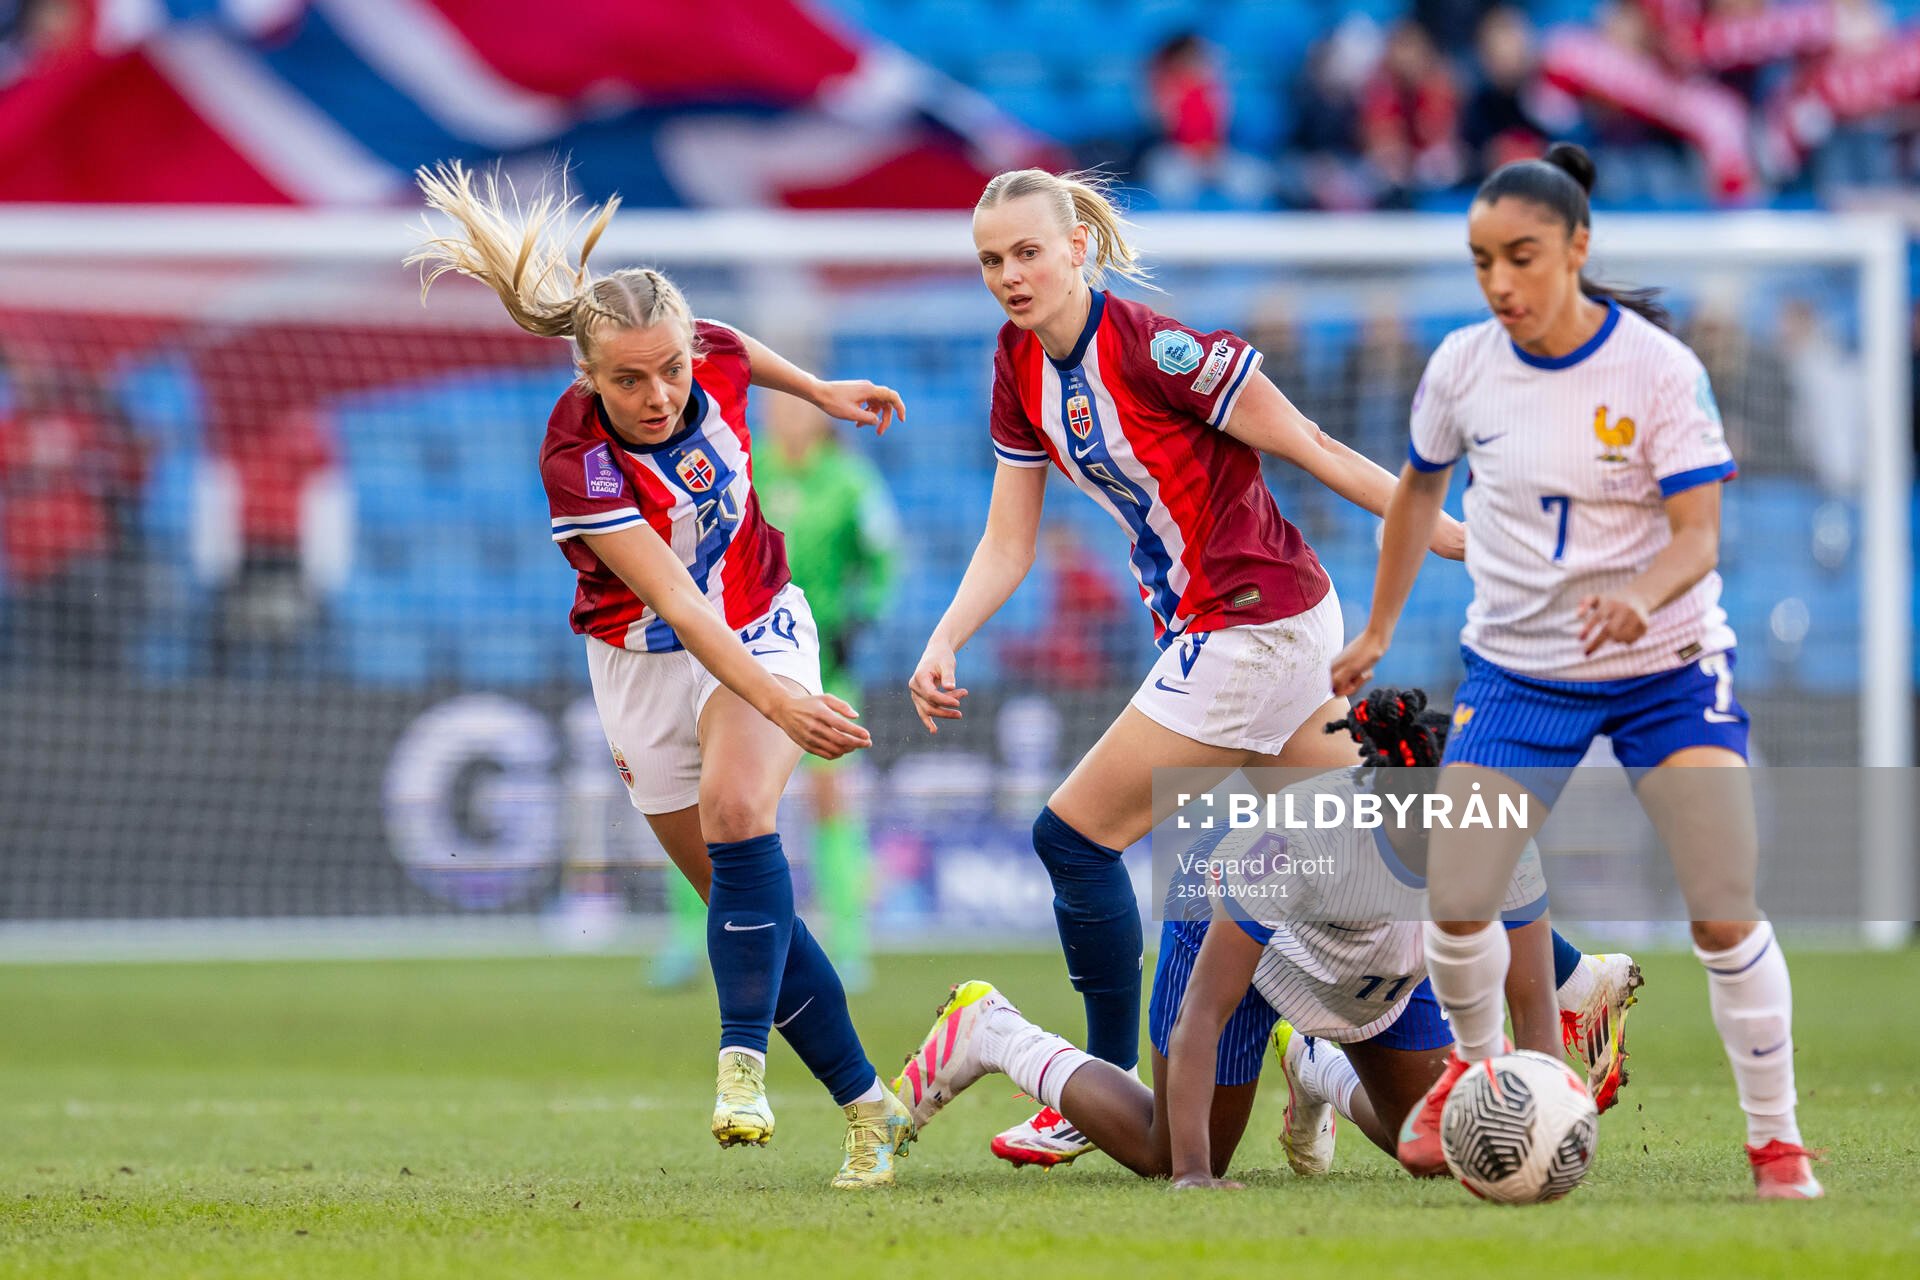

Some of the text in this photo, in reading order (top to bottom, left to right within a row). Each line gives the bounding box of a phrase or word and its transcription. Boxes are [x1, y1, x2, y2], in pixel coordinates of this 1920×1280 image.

[590, 480, 619, 489] NATIONS
[592, 485, 617, 494] LEAGUE
[1540, 496, 1569, 560] 7
[1699, 651, 1733, 713] 7
[1355, 975, 1412, 1002] 11
